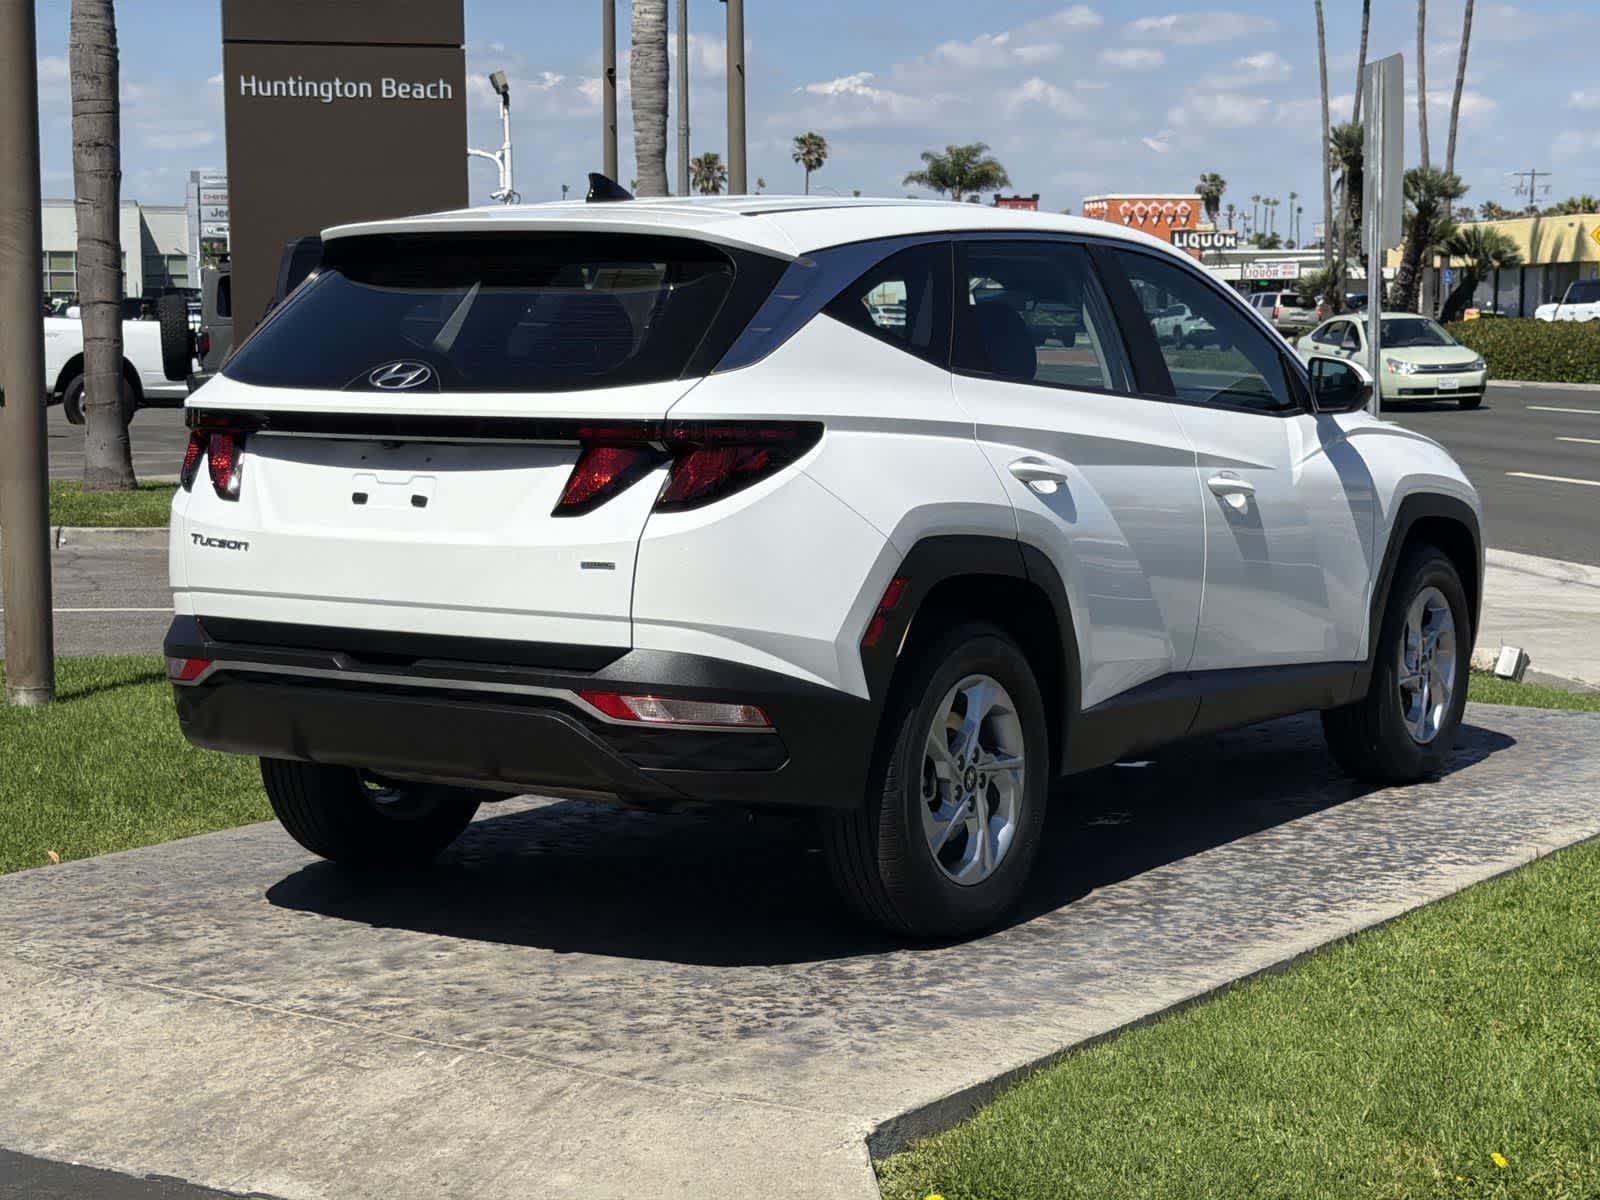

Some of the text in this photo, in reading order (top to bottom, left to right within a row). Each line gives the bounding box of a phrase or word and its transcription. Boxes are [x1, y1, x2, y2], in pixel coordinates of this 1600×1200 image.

[240, 74, 453, 103] Huntington Beach
[1173, 231, 1236, 248] LIQUOR
[1243, 268, 1280, 278] LIQUOR
